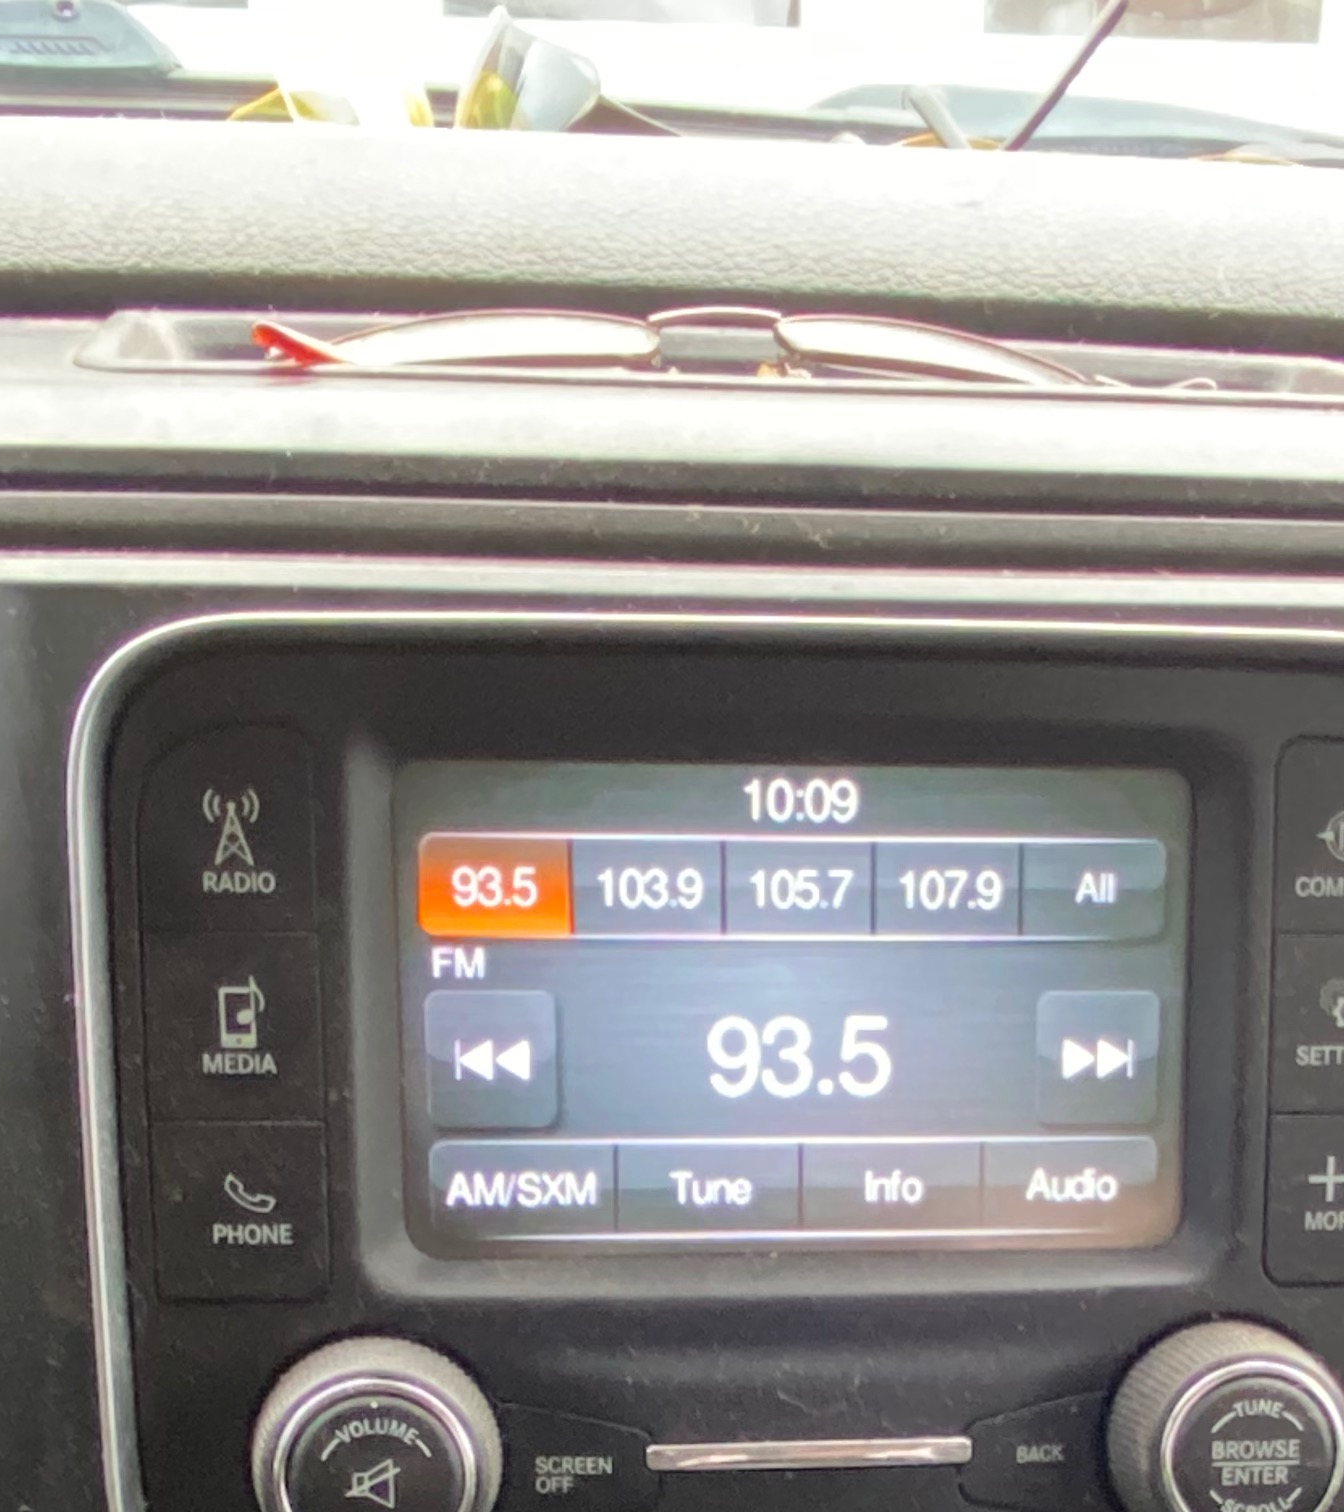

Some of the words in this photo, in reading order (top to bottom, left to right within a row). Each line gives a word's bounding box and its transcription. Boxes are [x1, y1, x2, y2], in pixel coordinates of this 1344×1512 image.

[743, 777, 859, 825] 10:09
[202, 870, 277, 895] RADIO
[450, 865, 539, 909] 93.5
[597, 868, 704, 911] 103.9
[750, 869, 854, 911] 105.7
[899, 870, 1004, 911] 107.9
[1074, 871, 1117, 906] All
[431, 947, 486, 981] FM
[201, 1052, 278, 1076] MEDIA
[706, 1014, 893, 1100] 93.5
[445, 1171, 598, 1209] AM/SXM
[669, 1170, 753, 1207] Tune
[863, 1170, 925, 1205] Info
[1025, 1167, 1119, 1203] Audio
[212, 1223, 294, 1246] PHONE
[1231, 1400, 1286, 1420] TUNE
[334, 1417, 420, 1447] VOLUME
[535, 1455, 613, 1477] SCREEN
[1016, 1445, 1064, 1464] BACK
[1211, 1439, 1301, 1461] BROWSE
[535, 1476, 575, 1495] OFF
[1220, 1465, 1289, 1487] ENTER
